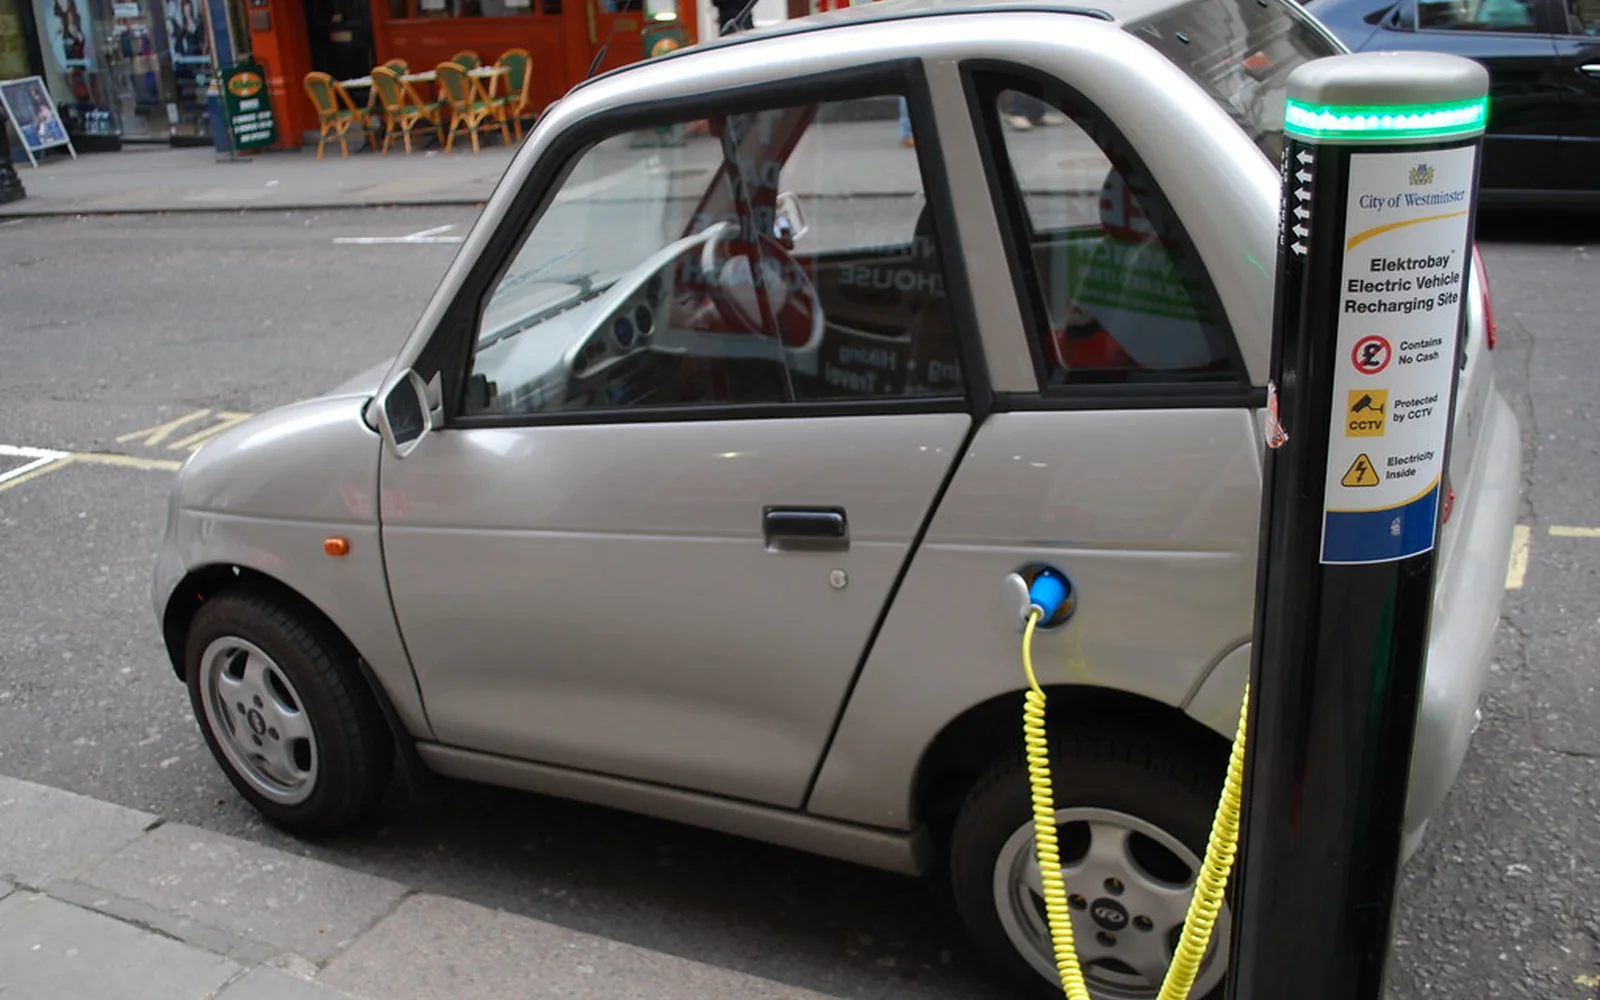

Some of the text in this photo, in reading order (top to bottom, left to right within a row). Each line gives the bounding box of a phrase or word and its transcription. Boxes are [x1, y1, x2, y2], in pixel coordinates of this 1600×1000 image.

[1359, 190, 1465, 211] City of Westminster
[1370, 255, 1450, 272] Elektrobay
[1347, 271, 1460, 293] Electric Vehicle
[1344, 292, 1459, 314] Recharging Site
[1399, 337, 1442, 351] Contains
[1398, 351, 1439, 365] No Cash
[1394, 393, 1439, 408] Protected
[1393, 407, 1433, 423] by CCTV
[1349, 420, 1382, 430] CCTV
[1387, 451, 1435, 467] Electricity
[1385, 468, 1417, 480] Inside
